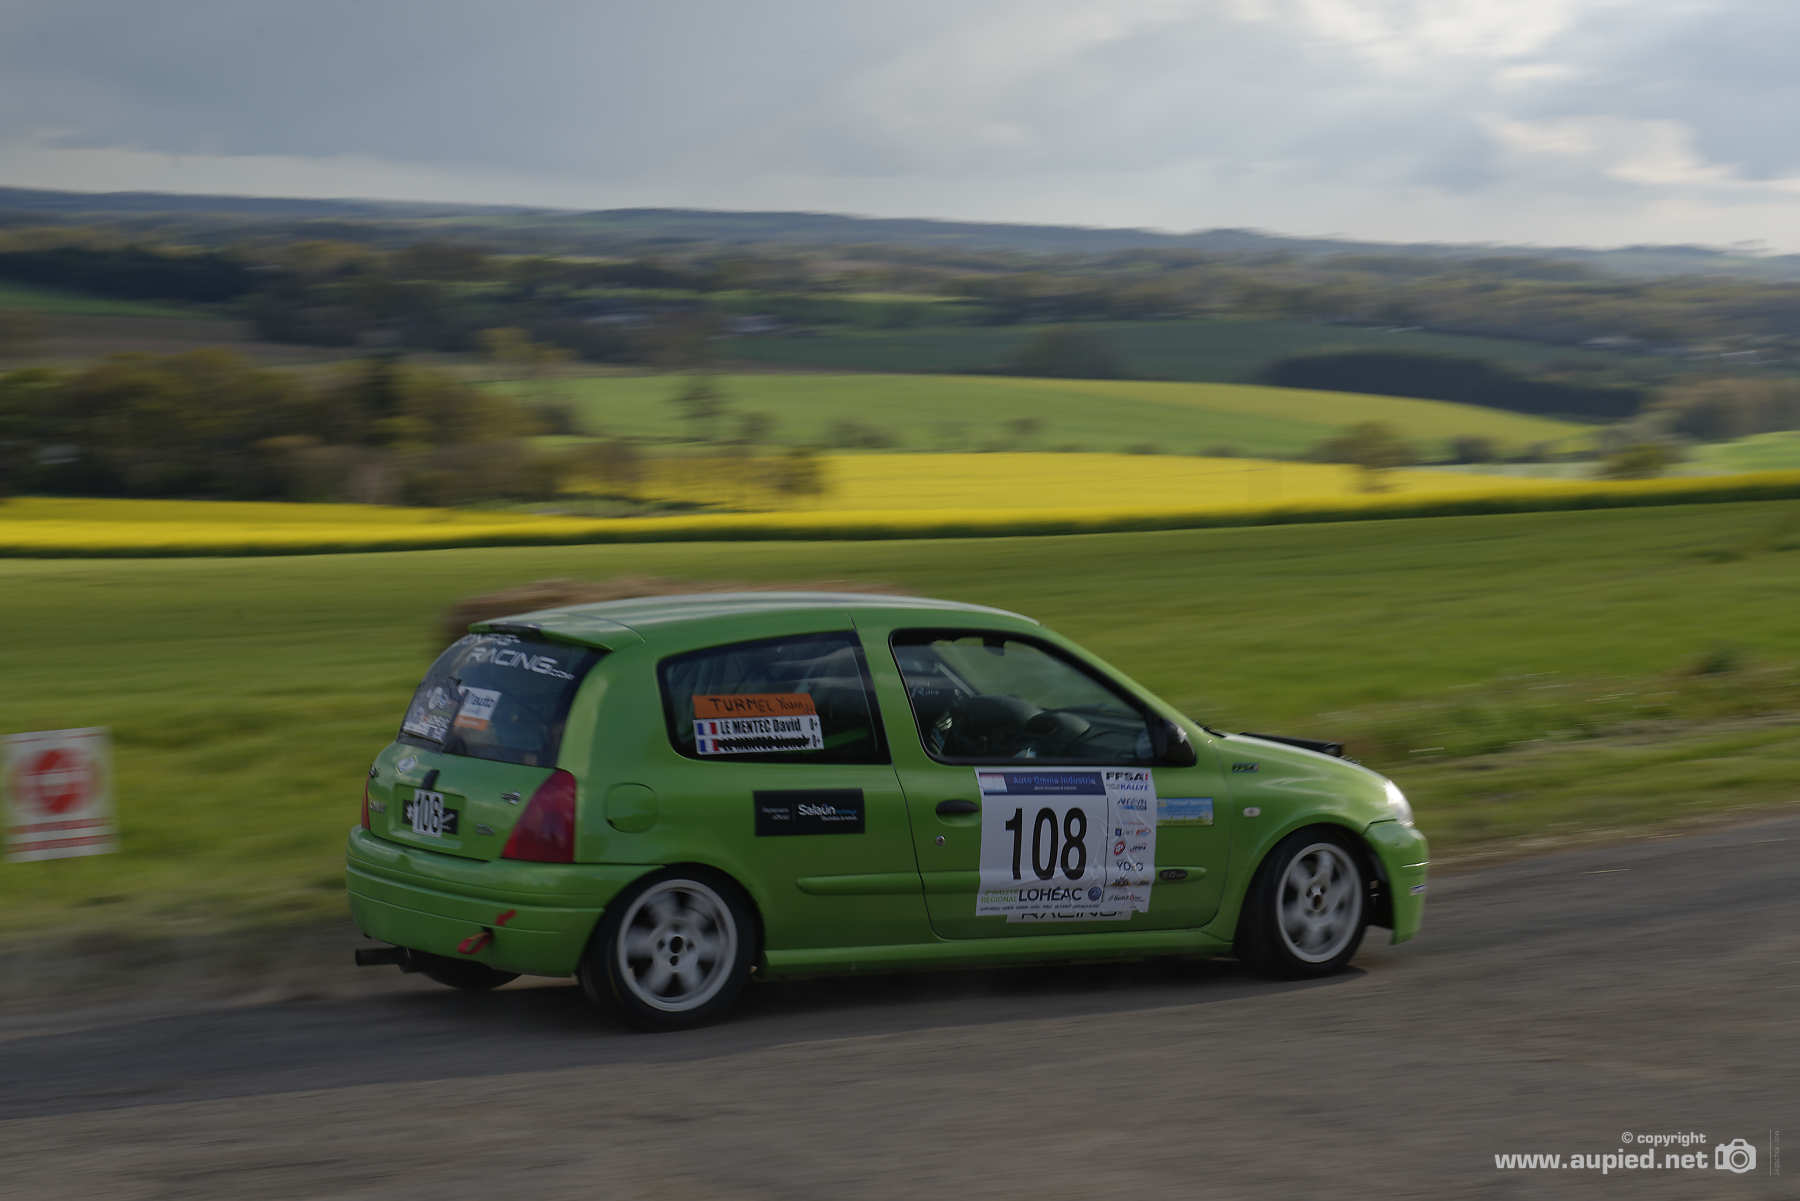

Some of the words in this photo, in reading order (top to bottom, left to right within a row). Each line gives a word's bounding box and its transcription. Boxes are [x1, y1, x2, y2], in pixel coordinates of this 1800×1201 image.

[720, 719, 731, 734] LE
[773, 717, 802, 733] David
[416, 792, 442, 833] 108
[1005, 807, 1087, 881] 108
[1018, 886, 1082, 902] LOHÉAC
